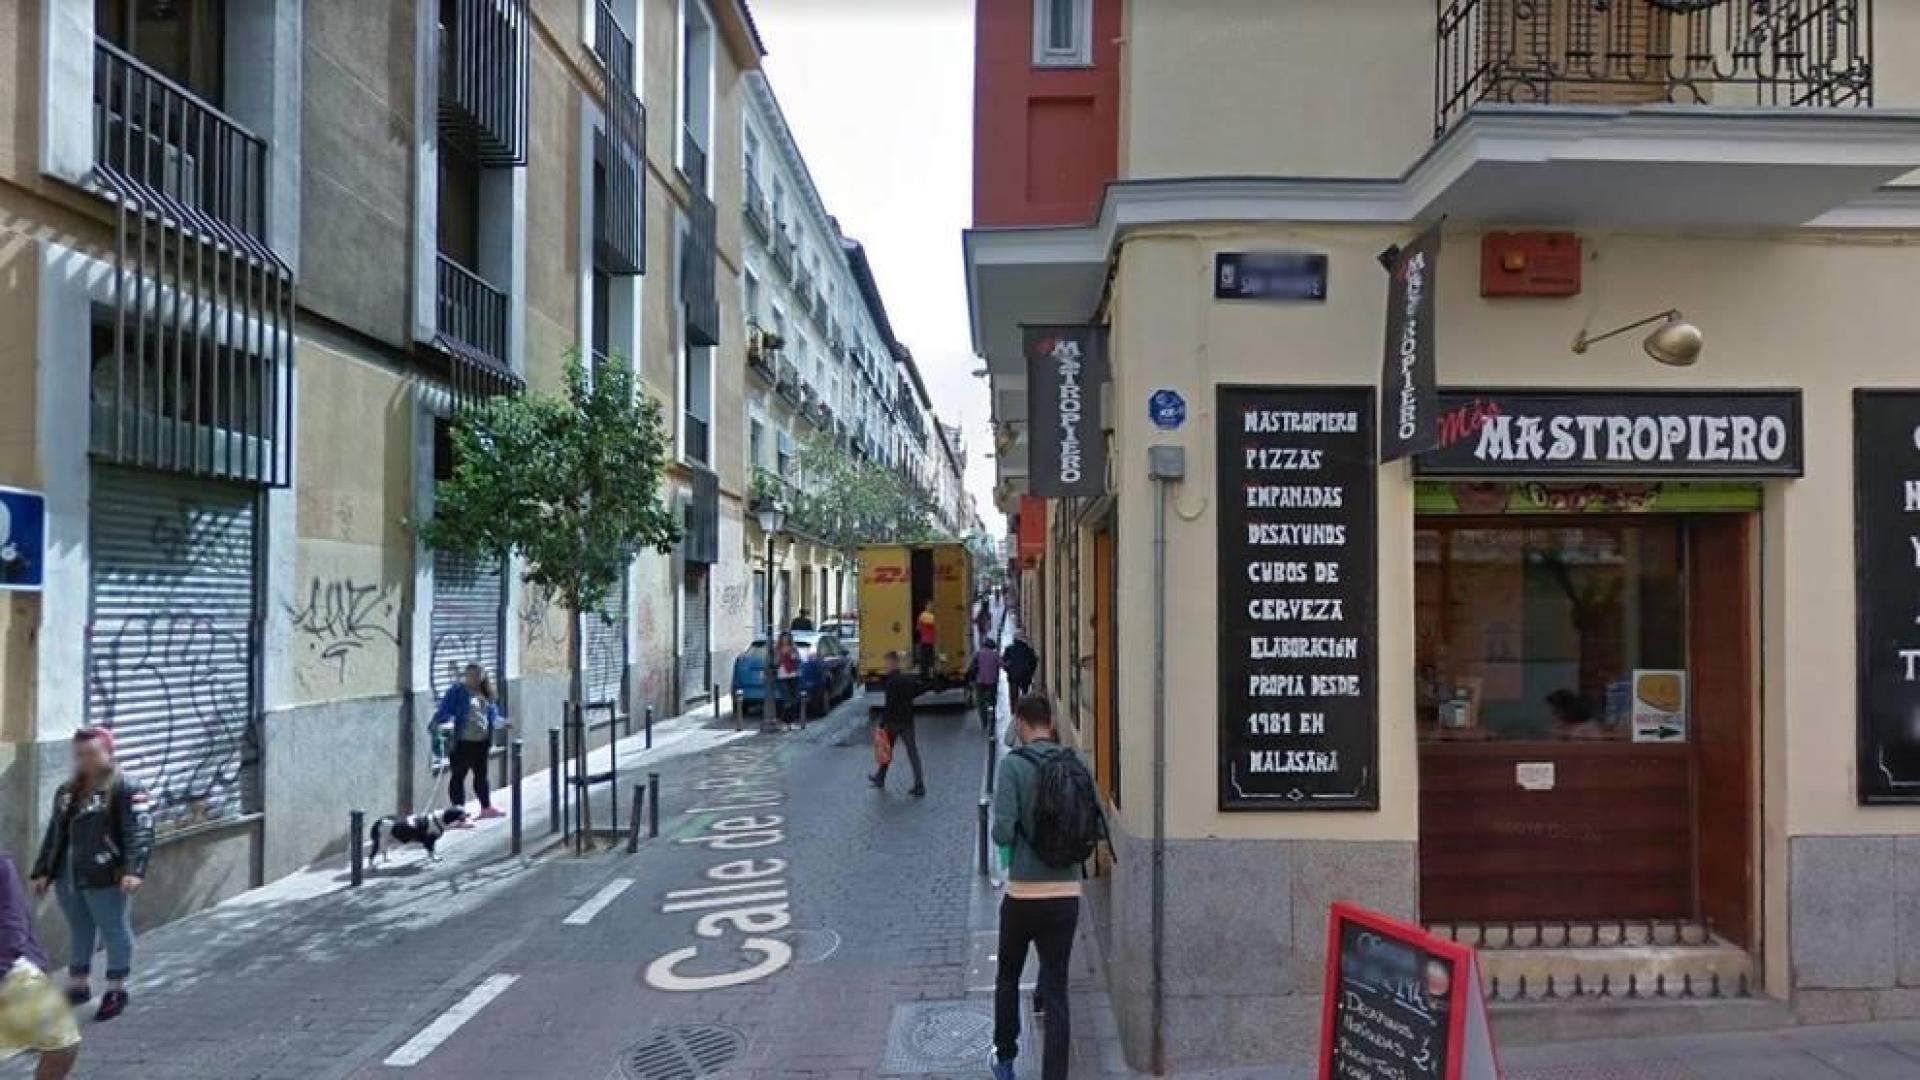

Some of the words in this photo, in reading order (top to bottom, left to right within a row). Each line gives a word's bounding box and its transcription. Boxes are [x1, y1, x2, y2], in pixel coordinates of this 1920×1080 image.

[1244, 411, 1358, 432] MASTROPIERO
[1474, 415, 1786, 461] MASTROPIERO
[1246, 448, 1323, 469] PIZZAS
[1246, 486, 1343, 507] EMPANADAS
[1248, 525, 1346, 546] DESAYUNOS
[1248, 562, 1307, 583] CUBOS
[1315, 562, 1339, 583] DE
[1249, 599, 1343, 621] CERVEZA
[1249, 675, 1305, 696] PROPIA
[1311, 675, 1360, 696] DESDE
[1249, 713, 1291, 734] 1981
[1300, 713, 1325, 734] EN
